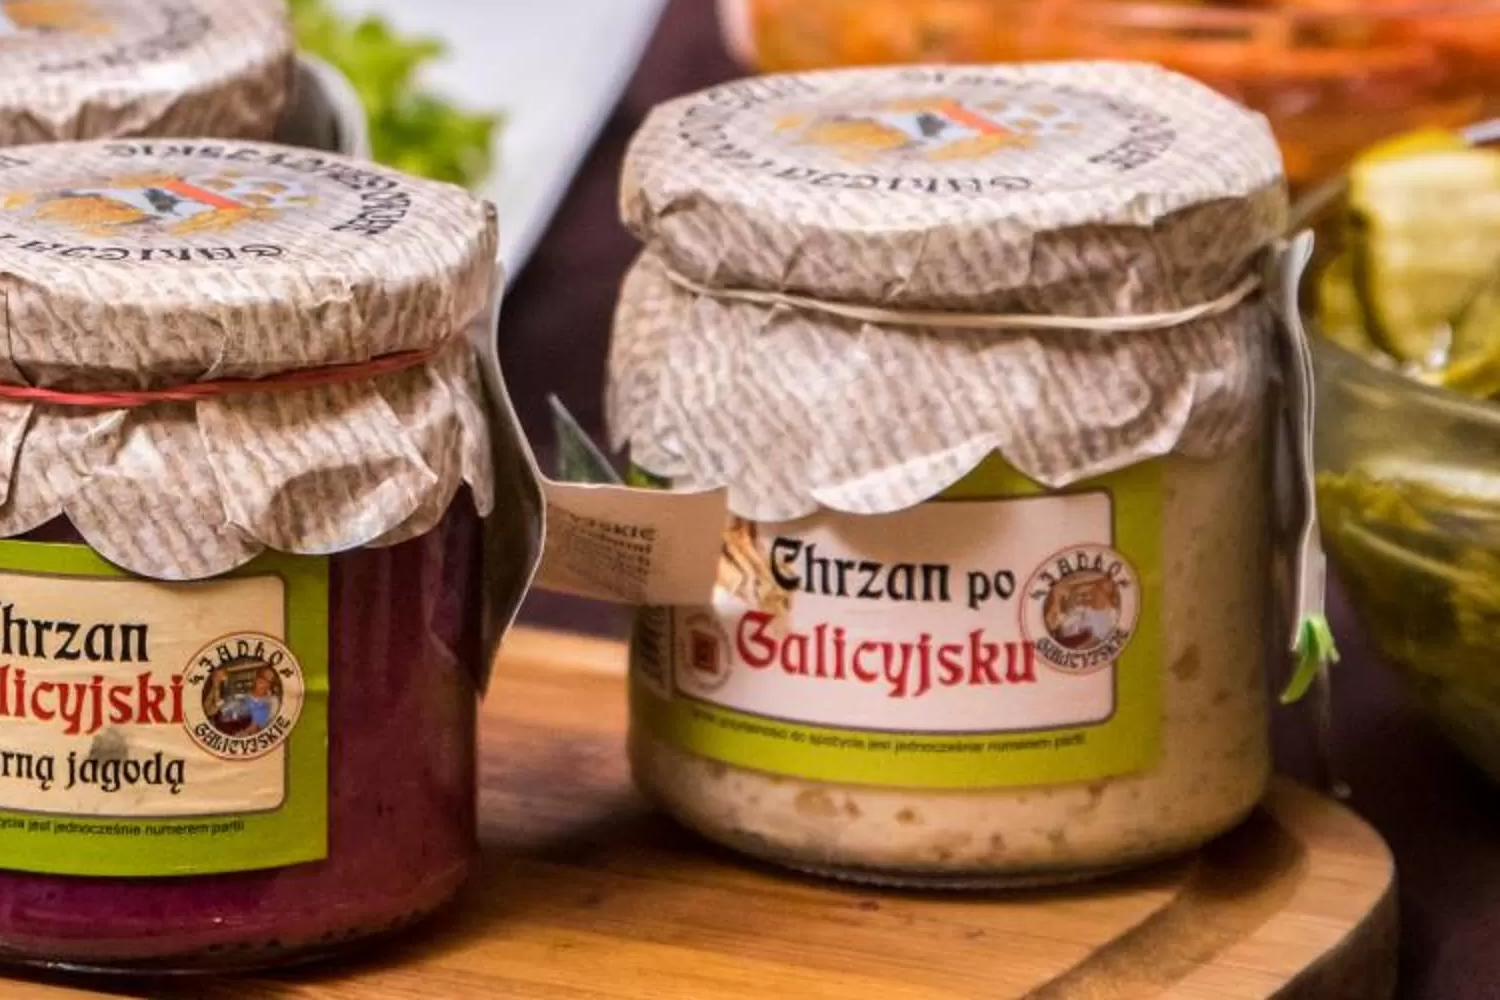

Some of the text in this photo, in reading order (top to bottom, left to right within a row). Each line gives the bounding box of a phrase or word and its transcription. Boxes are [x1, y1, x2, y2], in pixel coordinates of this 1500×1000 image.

[17, 240, 284, 262] GALICJA
[769, 536, 1015, 610] Chrzan po
[735, 609, 1038, 699] Galicyjsku
[66, 750, 186, 795] jagodą
